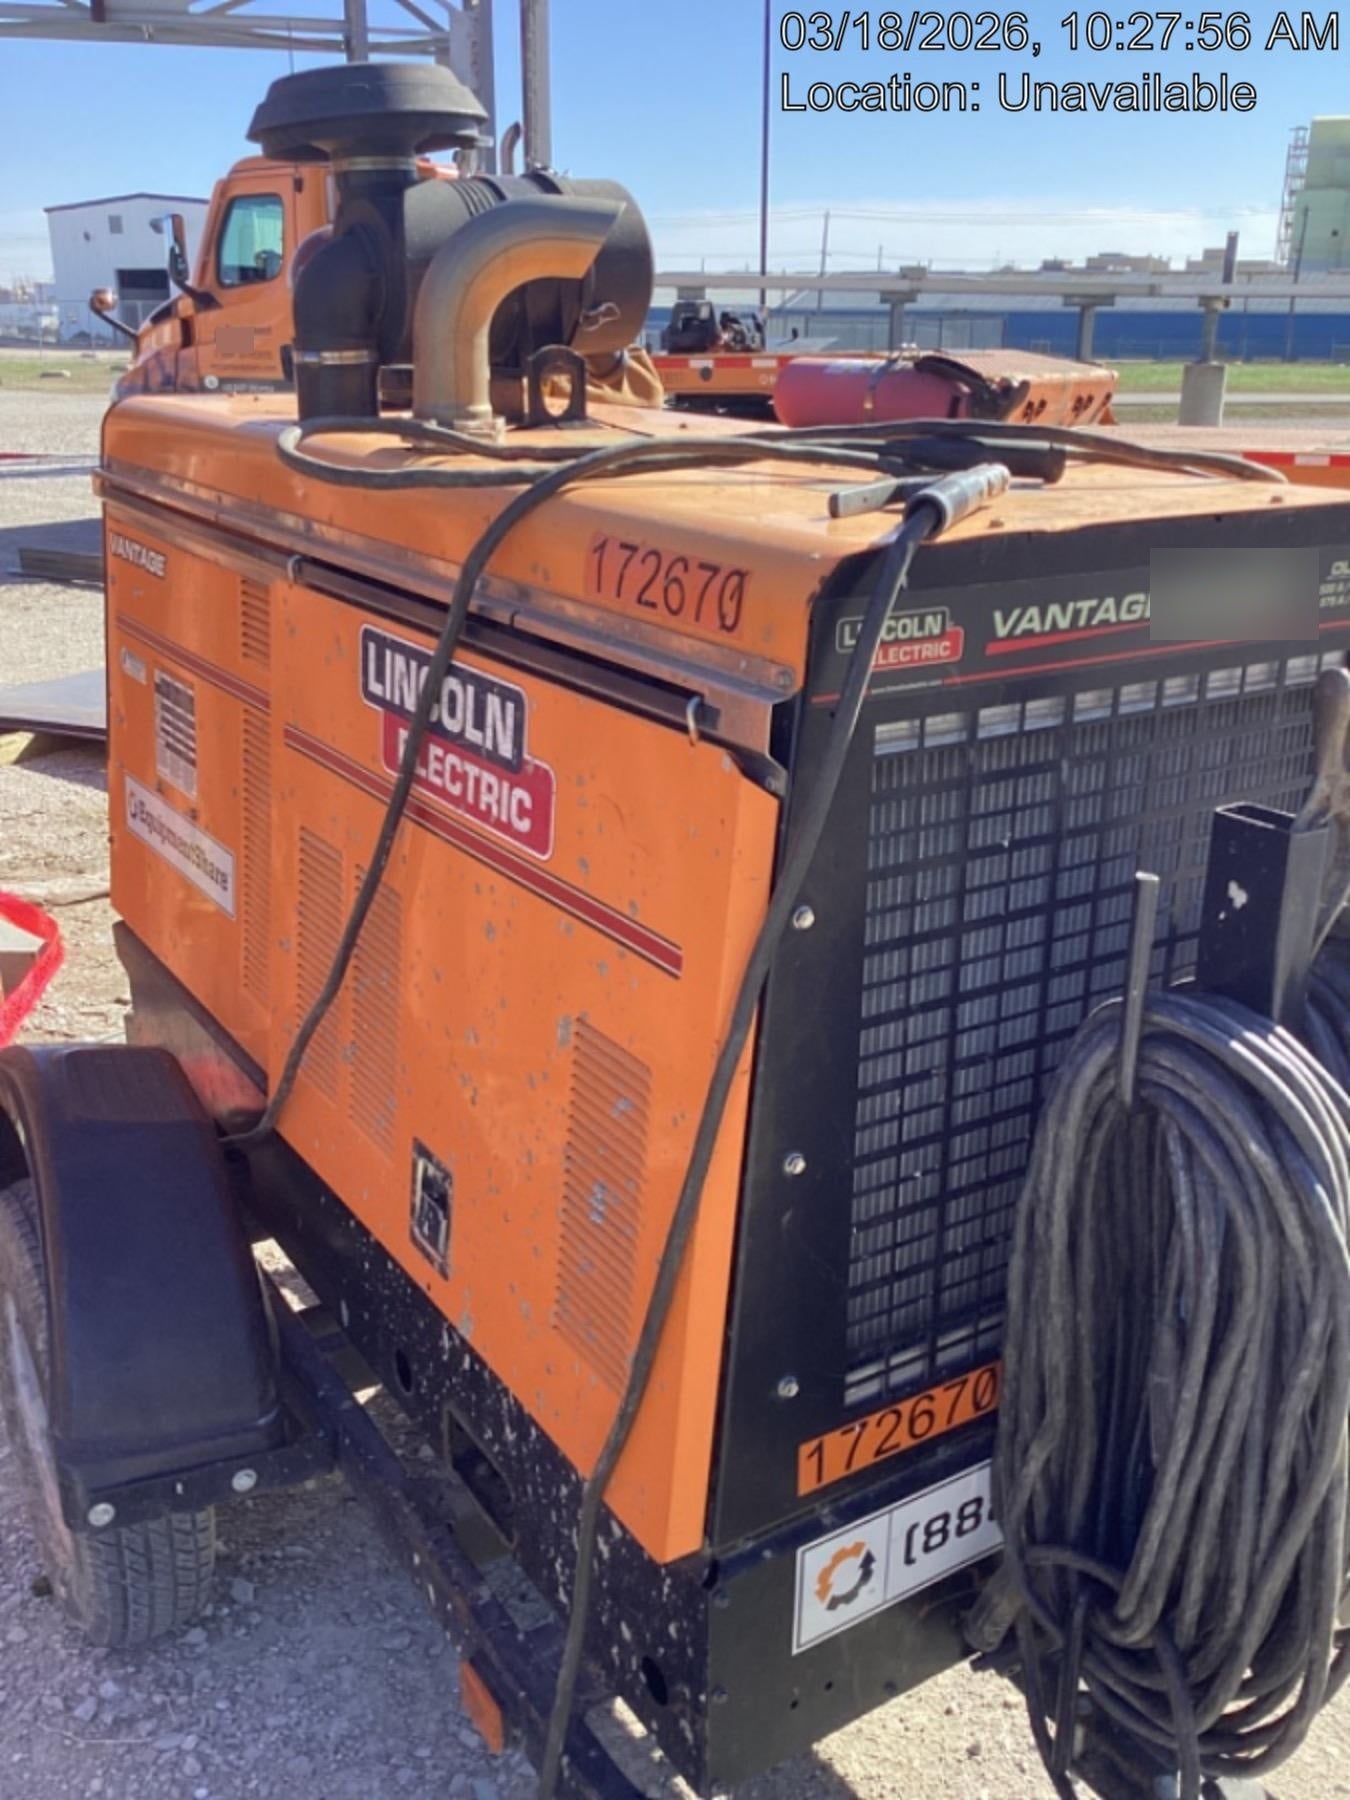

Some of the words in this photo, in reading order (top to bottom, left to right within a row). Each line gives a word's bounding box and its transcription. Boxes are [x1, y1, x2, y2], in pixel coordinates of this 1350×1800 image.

[111, 533, 166, 578] VANTAGE
[592, 537, 749, 633] 172670
[843, 613, 943, 647] LCOLN
[993, 592, 1151, 638] VANTAG
[873, 641, 952, 666] LECTRIC
[804, 1366, 999, 1485] 172670
[903, 1495, 995, 1567] (88
